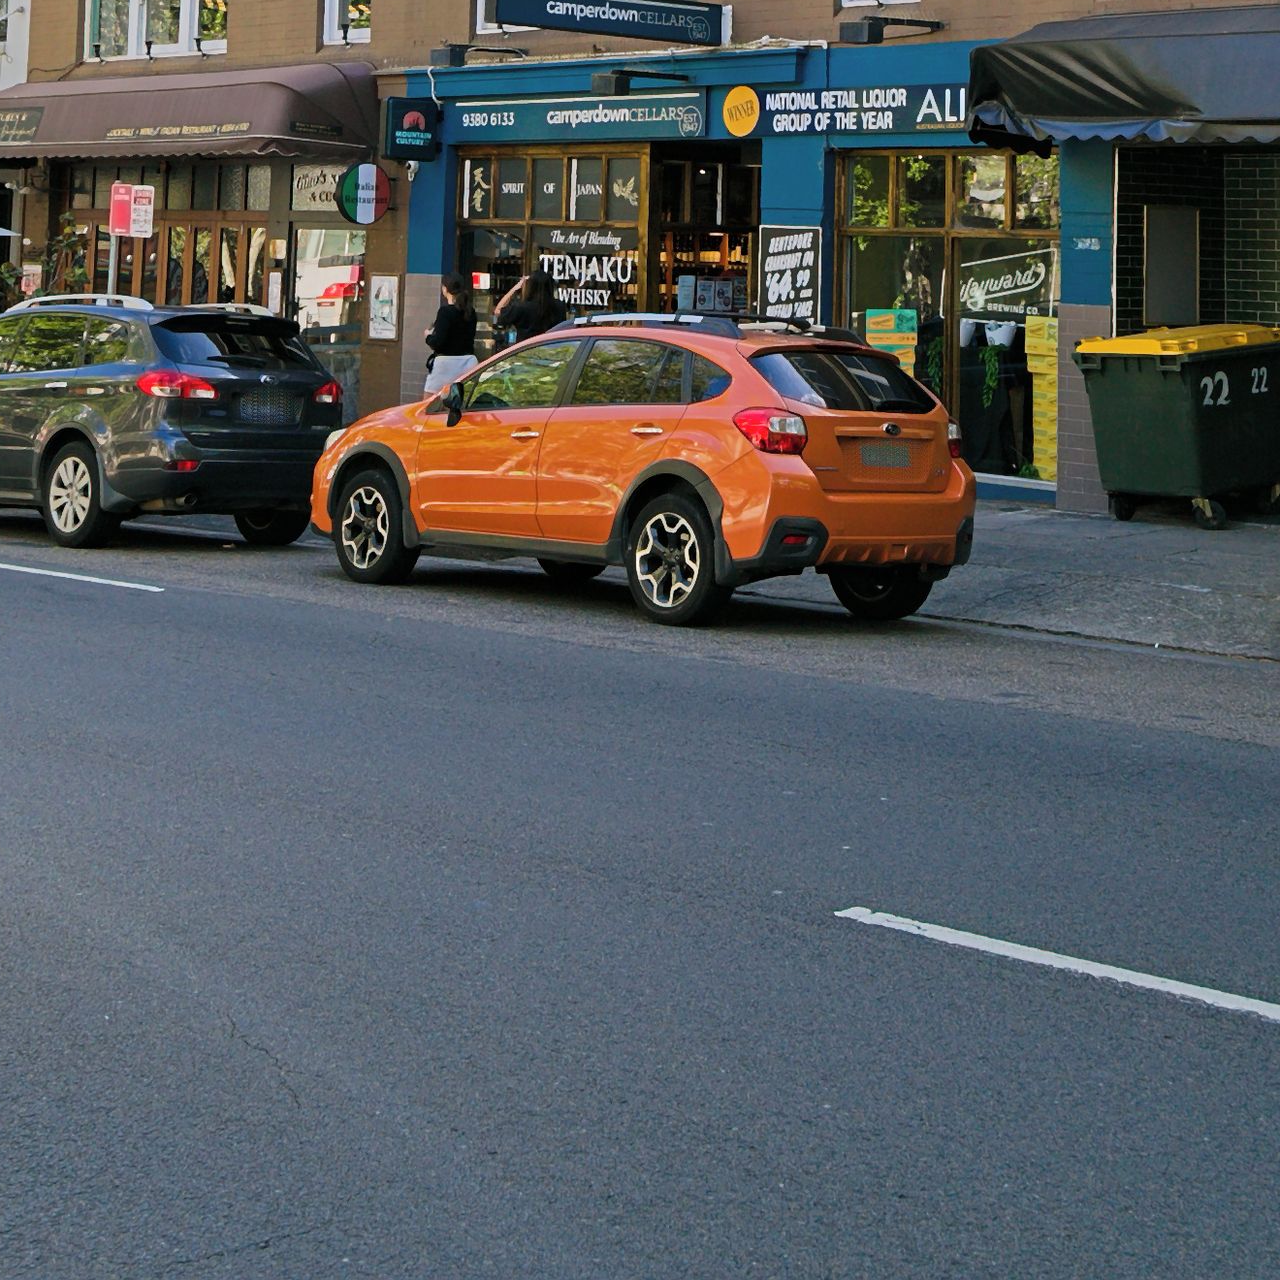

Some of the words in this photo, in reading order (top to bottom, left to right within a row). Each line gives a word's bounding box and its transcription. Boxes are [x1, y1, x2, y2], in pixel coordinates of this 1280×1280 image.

[766, 92, 818, 111] NATIONAL
[821, 91, 858, 109] RETAIL
[863, 88, 906, 108] LIQUOR
[462, 113, 488, 127] 9380
[490, 112, 514, 126] 6133
[727, 100, 755, 123] WINNER
[773, 113, 811, 132] GROUP
[815, 112, 831, 131] OF
[834, 112, 857, 130] THE
[861, 111, 892, 130] YEAR
[395, 131, 432, 139] MOUNTAIN
[502, 182, 525, 194] SPIRIT
[543, 182, 556, 194] OF
[576, 184, 602, 197] JAPAN
[551, 230, 565, 243] The
[567, 232, 579, 243] Art
[579, 231, 588, 249] of
[589, 232, 622, 250] Blending
[539, 254, 634, 286] TENJAKU
[558, 287, 611, 306] WHISKY
[987, 303, 1024, 314] BREWING
[1200, 371, 1231, 406] 22
[1251, 366, 1268, 393] 22
